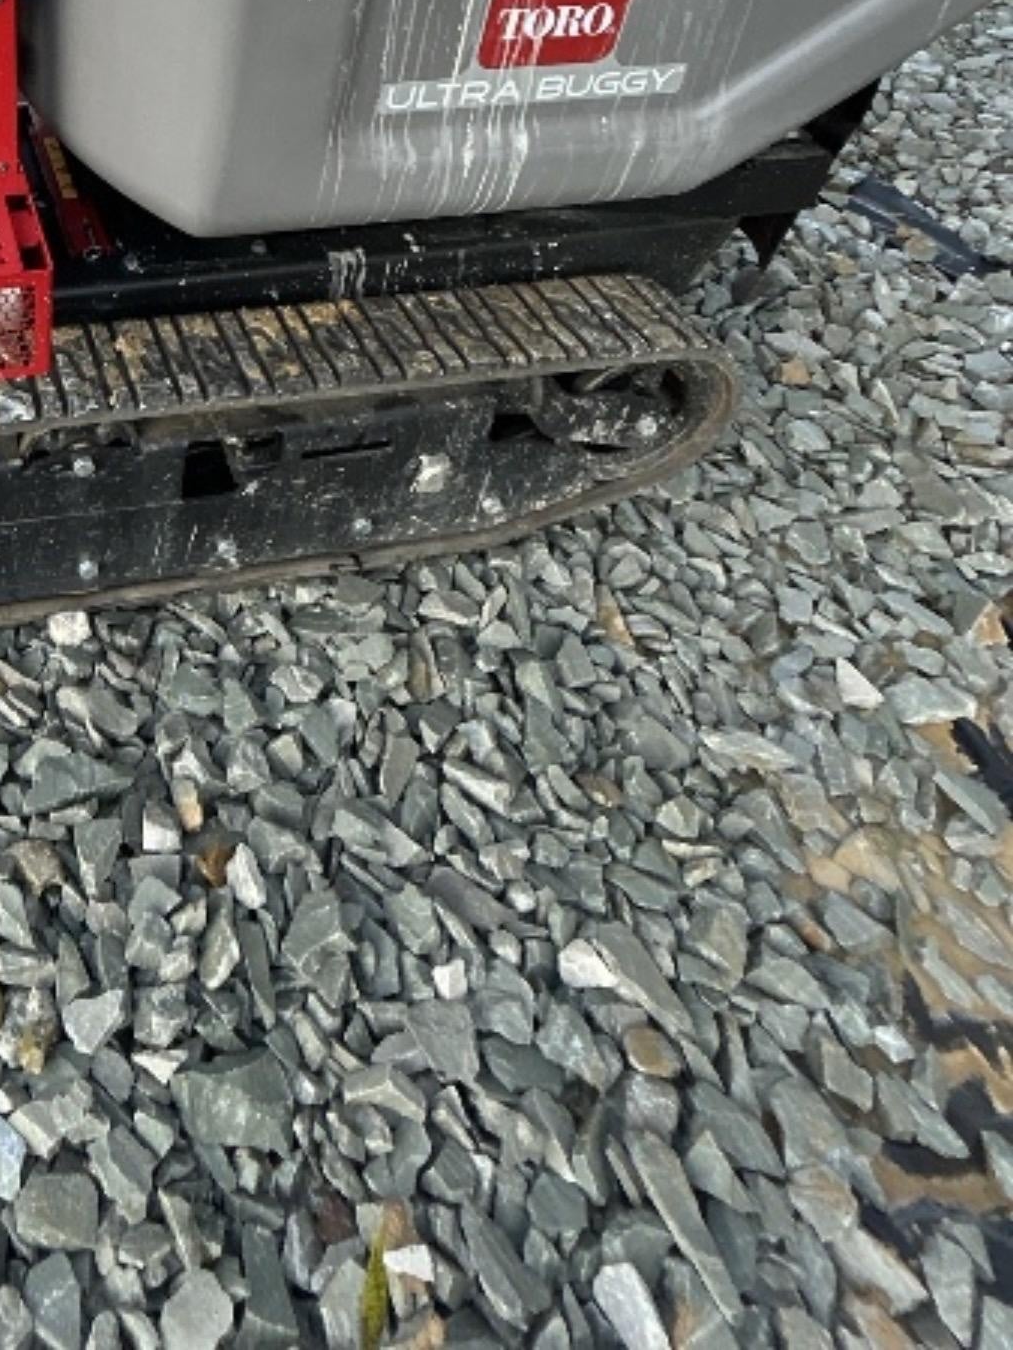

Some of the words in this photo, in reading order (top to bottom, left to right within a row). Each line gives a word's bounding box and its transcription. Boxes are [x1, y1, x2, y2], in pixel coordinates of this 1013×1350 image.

[499, 2, 616, 41] TORO
[386, 79, 521, 109] ULTRA
[536, 67, 678, 100] BUGGY
